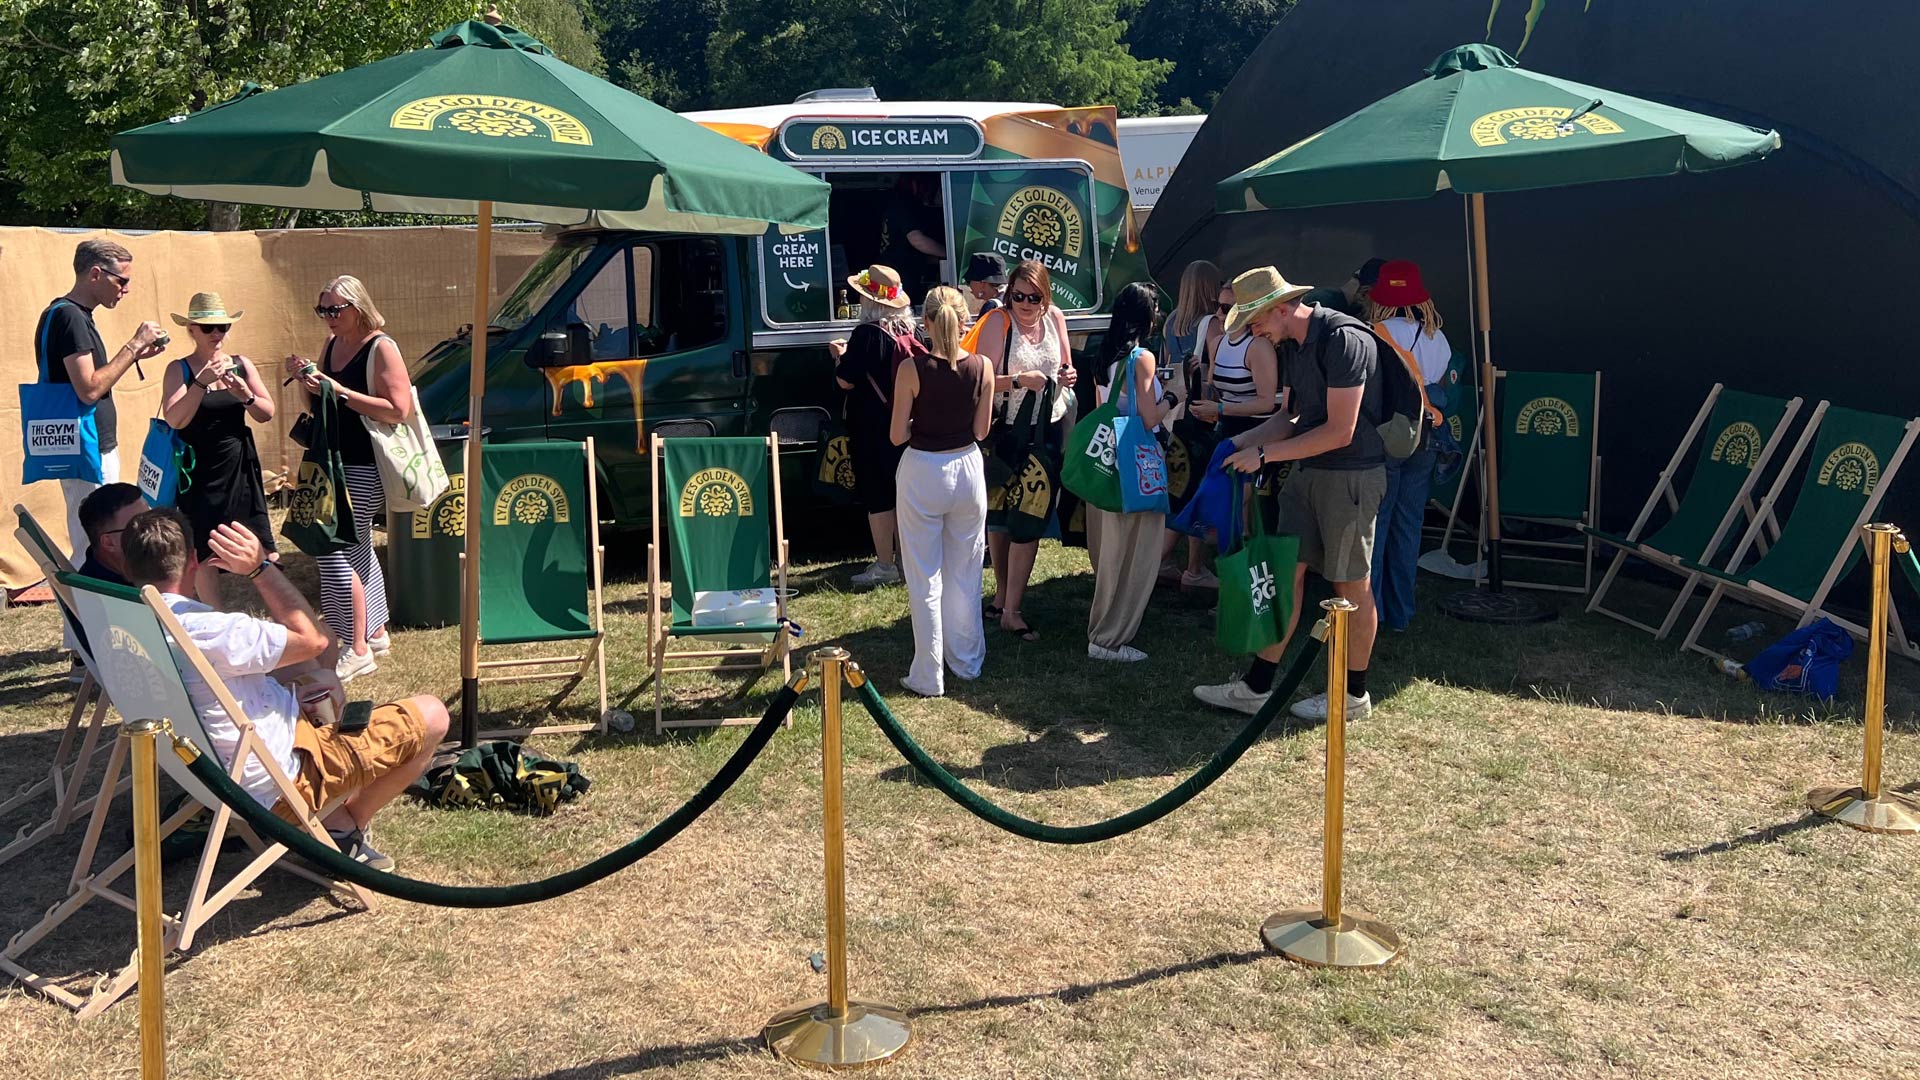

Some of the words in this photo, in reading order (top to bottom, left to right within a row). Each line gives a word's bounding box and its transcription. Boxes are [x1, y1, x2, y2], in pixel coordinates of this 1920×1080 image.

[400, 101, 441, 126] LYLE'S
[439, 97, 545, 115] GOLDEN
[541, 113, 583, 142] SYRUP
[1479, 121, 1499, 144] LYLE'S
[1491, 108, 1566, 122] GOLDEN
[1580, 113, 1614, 132] YRUP
[852, 129, 882, 146] ICE
[884, 129, 949, 146] CREAM
[1134, 187, 1161, 195] Venue
[1001, 196, 1025, 231] LYLE'S
[1024, 189, 1072, 214] GOLDEN
[1066, 214, 1080, 252] SYRUP
[773, 243, 819, 255] CREAM
[779, 256, 814, 268] HERE
[992, 237, 1019, 258] ICE
[1021, 247, 1078, 276] CREAM
[1051, 282, 1083, 309] SWIRLS
[31, 425, 45, 435] THE
[45, 424, 75, 435] GYM
[1532, 399, 1566, 412] GOLDEN
[1564, 408, 1577, 434] SYRUP
[1730, 424, 1757, 438] GOLDEN
[32, 435, 75, 446] KITCHEN
[1840, 445, 1872, 462] GOLDEN
[1867, 460, 1878, 492] SYRUP
[510, 477, 552, 492] GOLDEN
[550, 487, 567, 518] SYRUP
[683, 482, 698, 512] LYLE'S
[695, 470, 736, 485] GOLDEN
[734, 481, 751, 512] SYRUP
